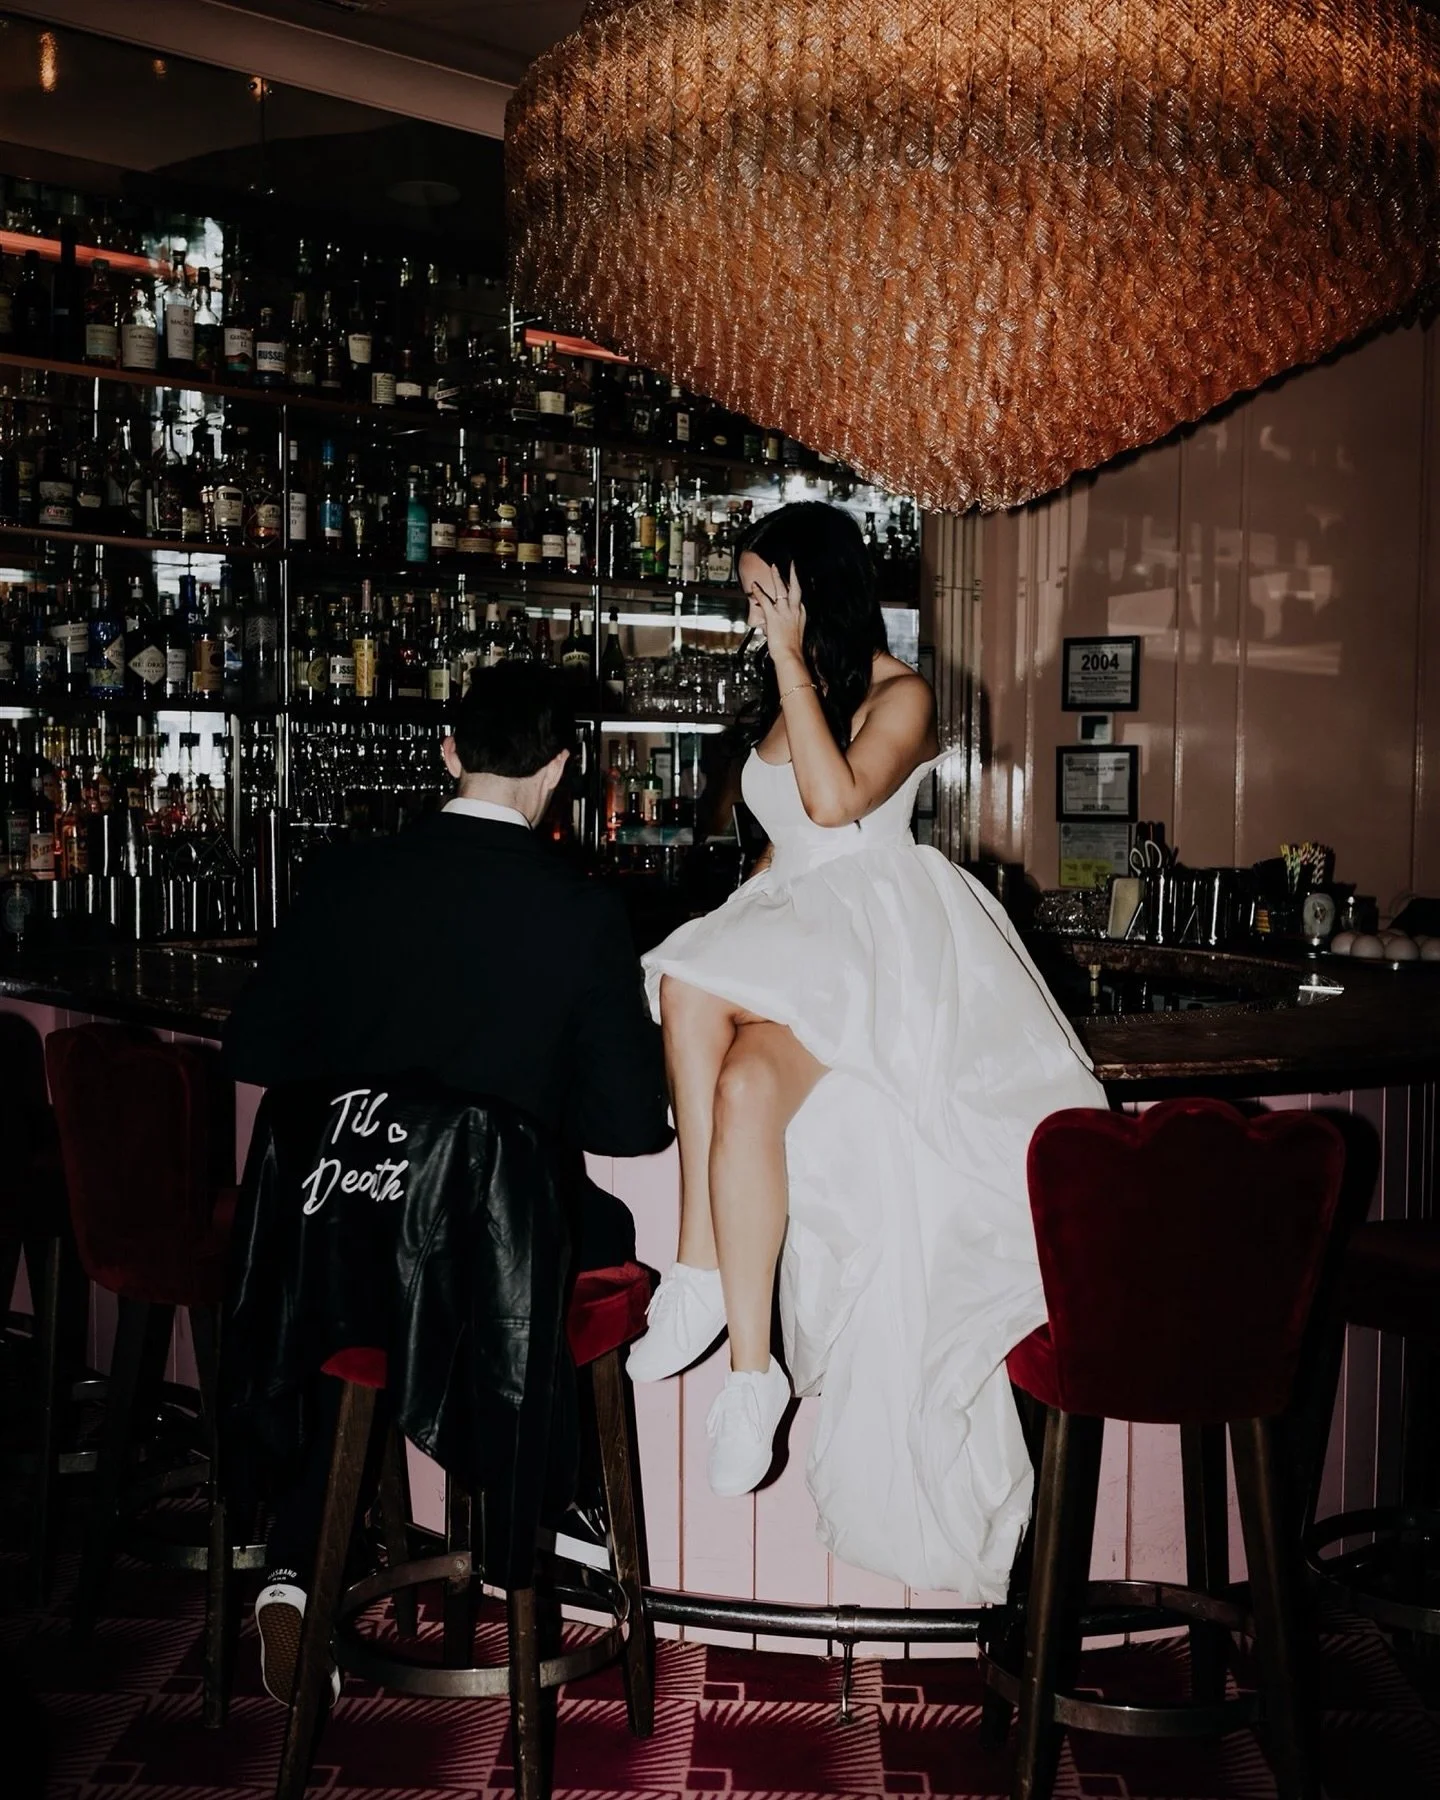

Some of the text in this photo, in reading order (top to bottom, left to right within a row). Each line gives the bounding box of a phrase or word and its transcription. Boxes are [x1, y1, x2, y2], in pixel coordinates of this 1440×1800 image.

[1081, 653, 1119, 671] 2004
[330, 1088, 389, 1145] Til
[301, 1157, 410, 1216] Death
